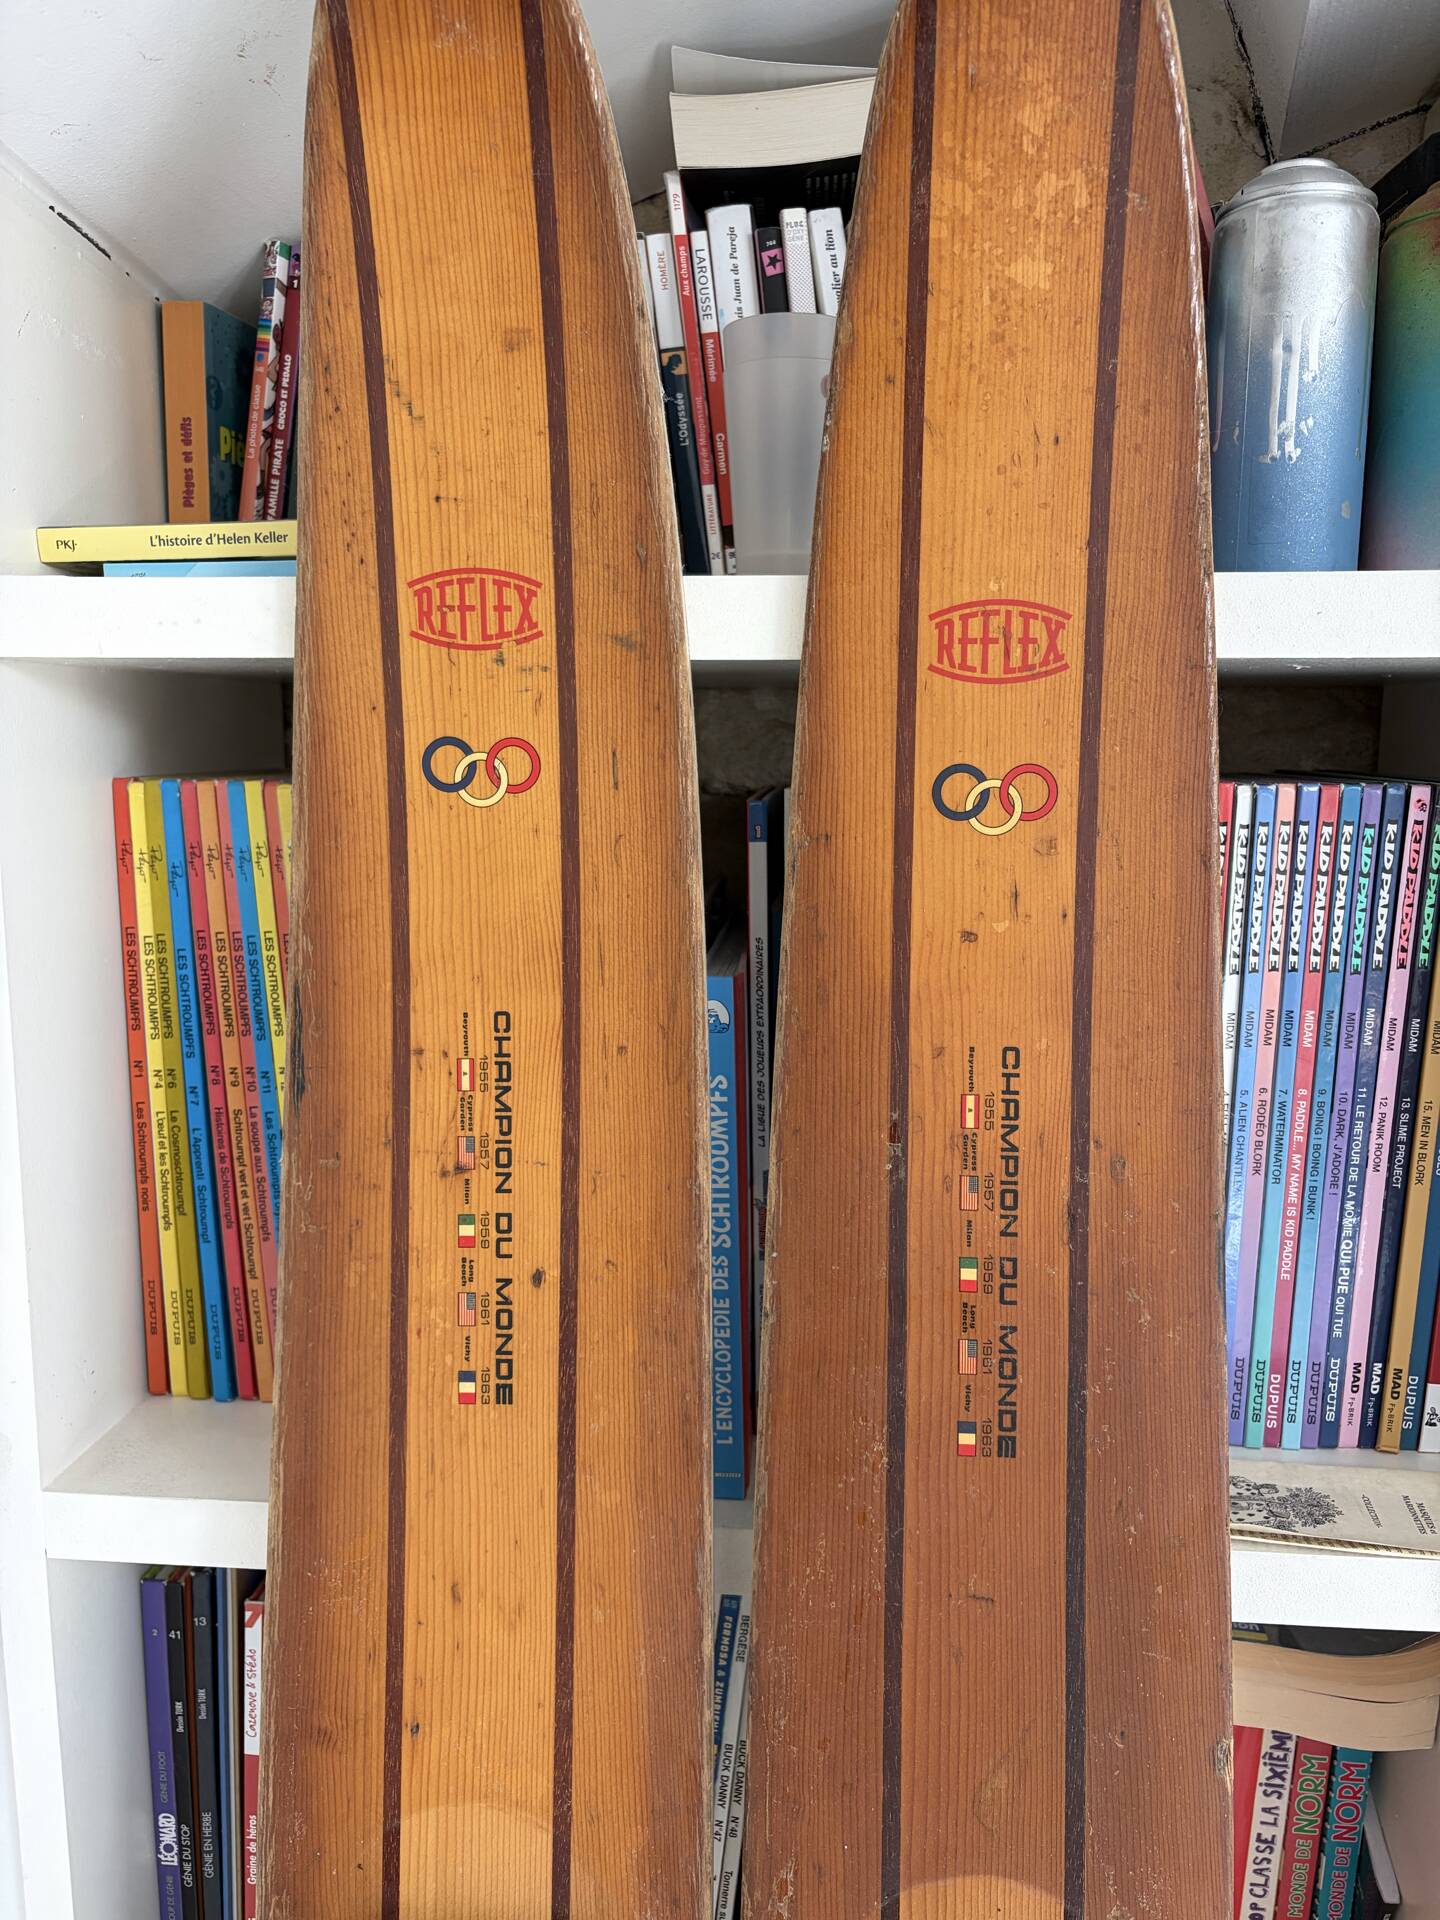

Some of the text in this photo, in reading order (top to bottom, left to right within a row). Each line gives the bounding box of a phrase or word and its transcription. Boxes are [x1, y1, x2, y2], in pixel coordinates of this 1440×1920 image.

[672, 193, 681, 211] 1179
[679, 246, 691, 296] Aux champs
[728, 226, 742, 303] Juan de Pareja
[825, 229, 839, 268] au lion
[695, 248, 713, 320] LAROUSSE
[247, 384, 261, 459] La photo de classe
[278, 389, 288, 430] CROCO ET
[182, 416, 195, 508] Pièges et défis
[272, 438, 284, 476] PIRATE
[716, 432, 727, 475] Carmen
[150, 531, 289, 548] L'histoire d'Helen Keller
[414, 577, 538, 641] REFLEX
[934, 609, 1066, 675] REFLEX
[1288, 821, 1310, 973] KID PADDLE
[125, 926, 141, 1031] LES SCHTROUMPFS
[143, 935, 160, 1040] LES SCHTROUMPFS
[156, 933, 174, 1039] LES SCHTROUMPFS
[176, 948, 196, 1059] LES SCHTROUMPFS
[215, 931, 235, 1037] LES SCHTROUMPFS
[755, 937, 765, 1148] LA LIGUE DES JOUEURS EXTRAORDINAIRES
[1302, 1009, 1315, 1047] MIDAM
[1408, 1018, 1421, 1052] MIDAM
[968, 1046, 976, 1093] Beyrouth
[459, 1097, 467, 1131] Garden
[466, 1095, 474, 1132] Cypress
[1252, 1099, 1268, 1176] RODÉO BLORK
[1271, 1101, 1287, 1184] WATERMINATOR
[1372, 1112, 1387, 1173] PANIK ROOM
[135, 1101, 151, 1212] Les Schtroumpfs noirs
[170, 1110, 188, 1216] Le Cosmoschtroumpf
[709, 1073, 732, 1250] SCHTROUMPFS
[962, 1134, 970, 1170] Garden
[970, 1132, 978, 1171] Cypress
[1391, 1112, 1410, 1188] SLIME PROJECT
[1414, 1116, 1432, 1186] MEN IN BLORK
[158, 1141, 174, 1231] et les Schtroumpfs
[197, 1185, 211, 1243] Schtroumpf
[233, 1108, 258, 1280] Schtroumpf vert et vert Schtroumpf
[494, 1010, 513, 1405] CHAMPION DU MONDE
[1280, 1101, 1307, 1280] PADDLE... MY NAME IS KID PADDLE
[479, 1054, 490, 1405] 1955 1957 1959 1961 1963
[998, 1046, 1020, 1458] CHAMPION DU MONDE
[1332, 1104, 1365, 1338] LE RETOUR DE LA MOMIE QUI PUE QUI TUE
[467, 1260, 475, 1283] Long
[713, 1254, 729, 1290] DES
[982, 1091, 995, 1458] 1955 1957 1959 1961 1963
[147, 1279, 158, 1335] DUPUIS
[170, 1290, 181, 1345] DUPUIS
[185, 1288, 196, 1344] DUPUIS
[969, 1305, 977, 1329] Long
[964, 1384, 972, 1412] Vichy
[1266, 1374, 1281, 1429] DUPUIS
[1325, 1357, 1341, 1422] DUPUIS
[1350, 1362, 1362, 1393] MAD
[168, 1630, 181, 1639] 41
[193, 1616, 207, 1627] 13
[245, 1692, 258, 1738] Cazenove
[717, 1744, 734, 1808] BUCK DANNY
[733, 1771, 746, 1805] DANNY
[157, 1812, 179, 1866] LÉONARD
[202, 1811, 214, 1878] GÉNIE EN HERBE
[1287, 1753, 1328, 1919] MONDE DE NORM
[1331, 1761, 1367, 1867] DE NORM
[181, 1824, 194, 1888] GÉNIE DU STOP
[246, 1815, 258, 1885] Graine de héros
[1249, 1806, 1280, 1899] CLASSE LA
